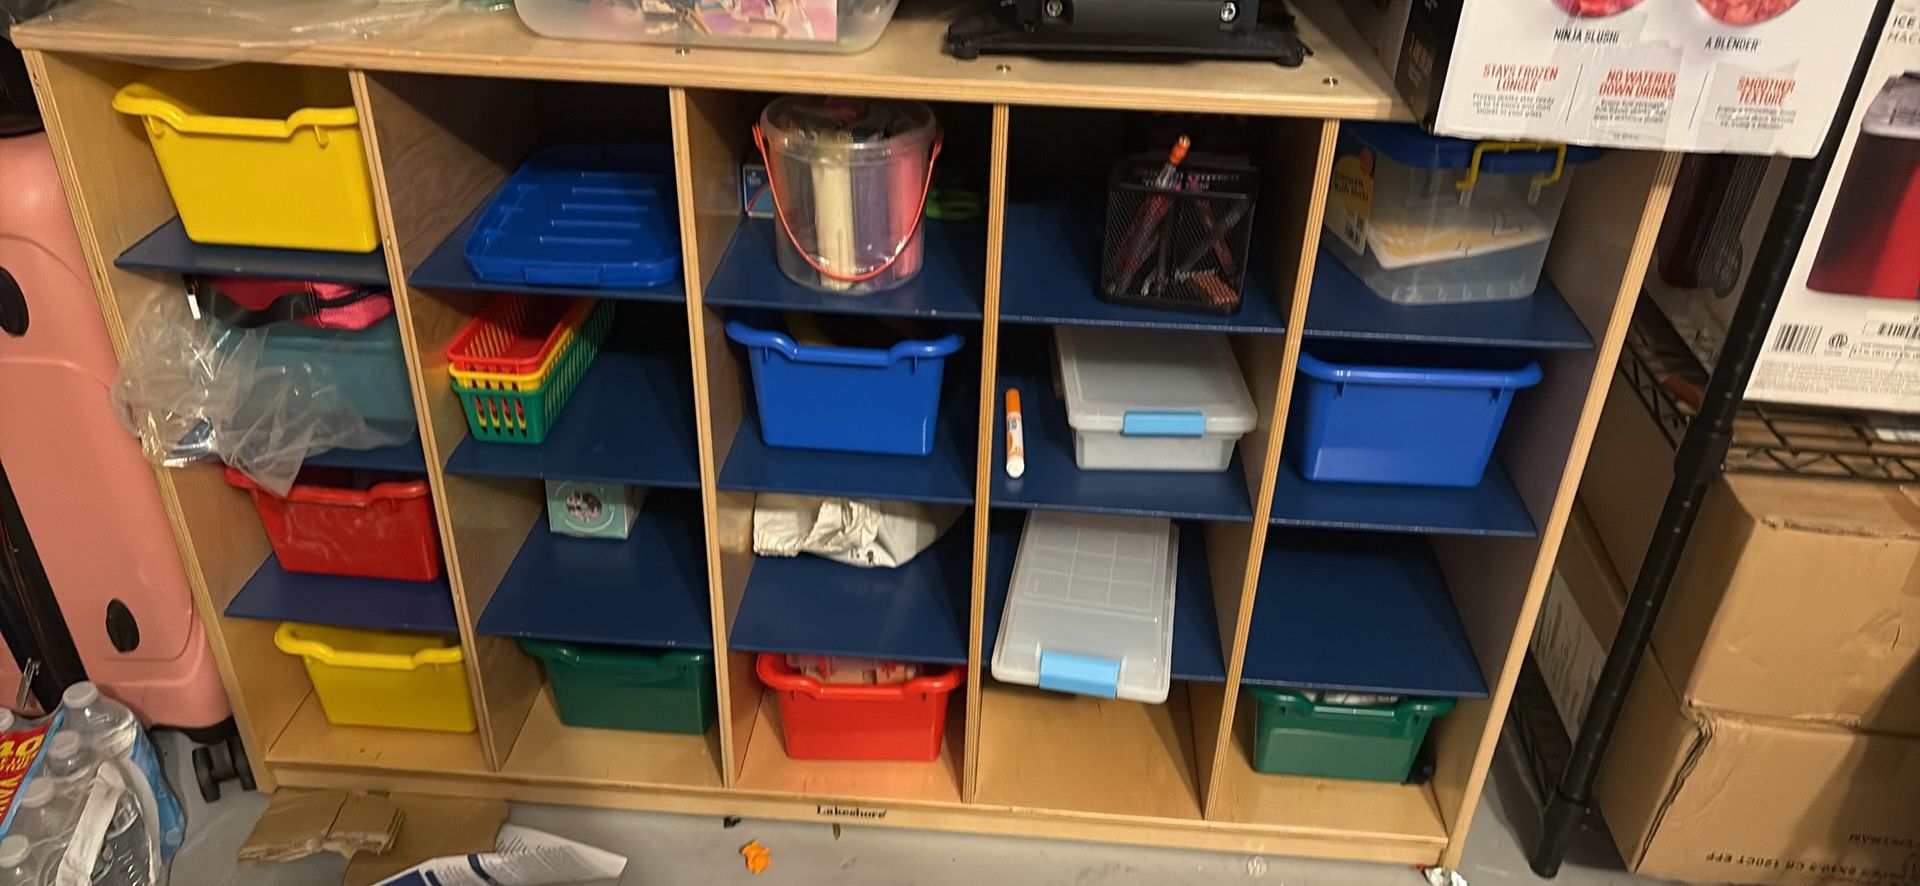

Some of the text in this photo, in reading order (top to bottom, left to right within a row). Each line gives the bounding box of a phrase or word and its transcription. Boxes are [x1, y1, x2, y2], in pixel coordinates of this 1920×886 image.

[1553, 28, 1582, 42] NINJA
[1887, 31, 1920, 45] MAC
[1704, 36, 1760, 53] A BLENDER
[1483, 63, 1558, 81] STAYS FROZEN
[1606, 69, 1676, 86] NO WATERED
[1496, 78, 1538, 93] LONGER
[1599, 83, 1676, 101] DOWN DRINKS
[1737, 76, 1796, 93] SMOOTHER
[1738, 89, 1787, 106] TEXTURE
[817, 805, 887, 819] Lakeshore
